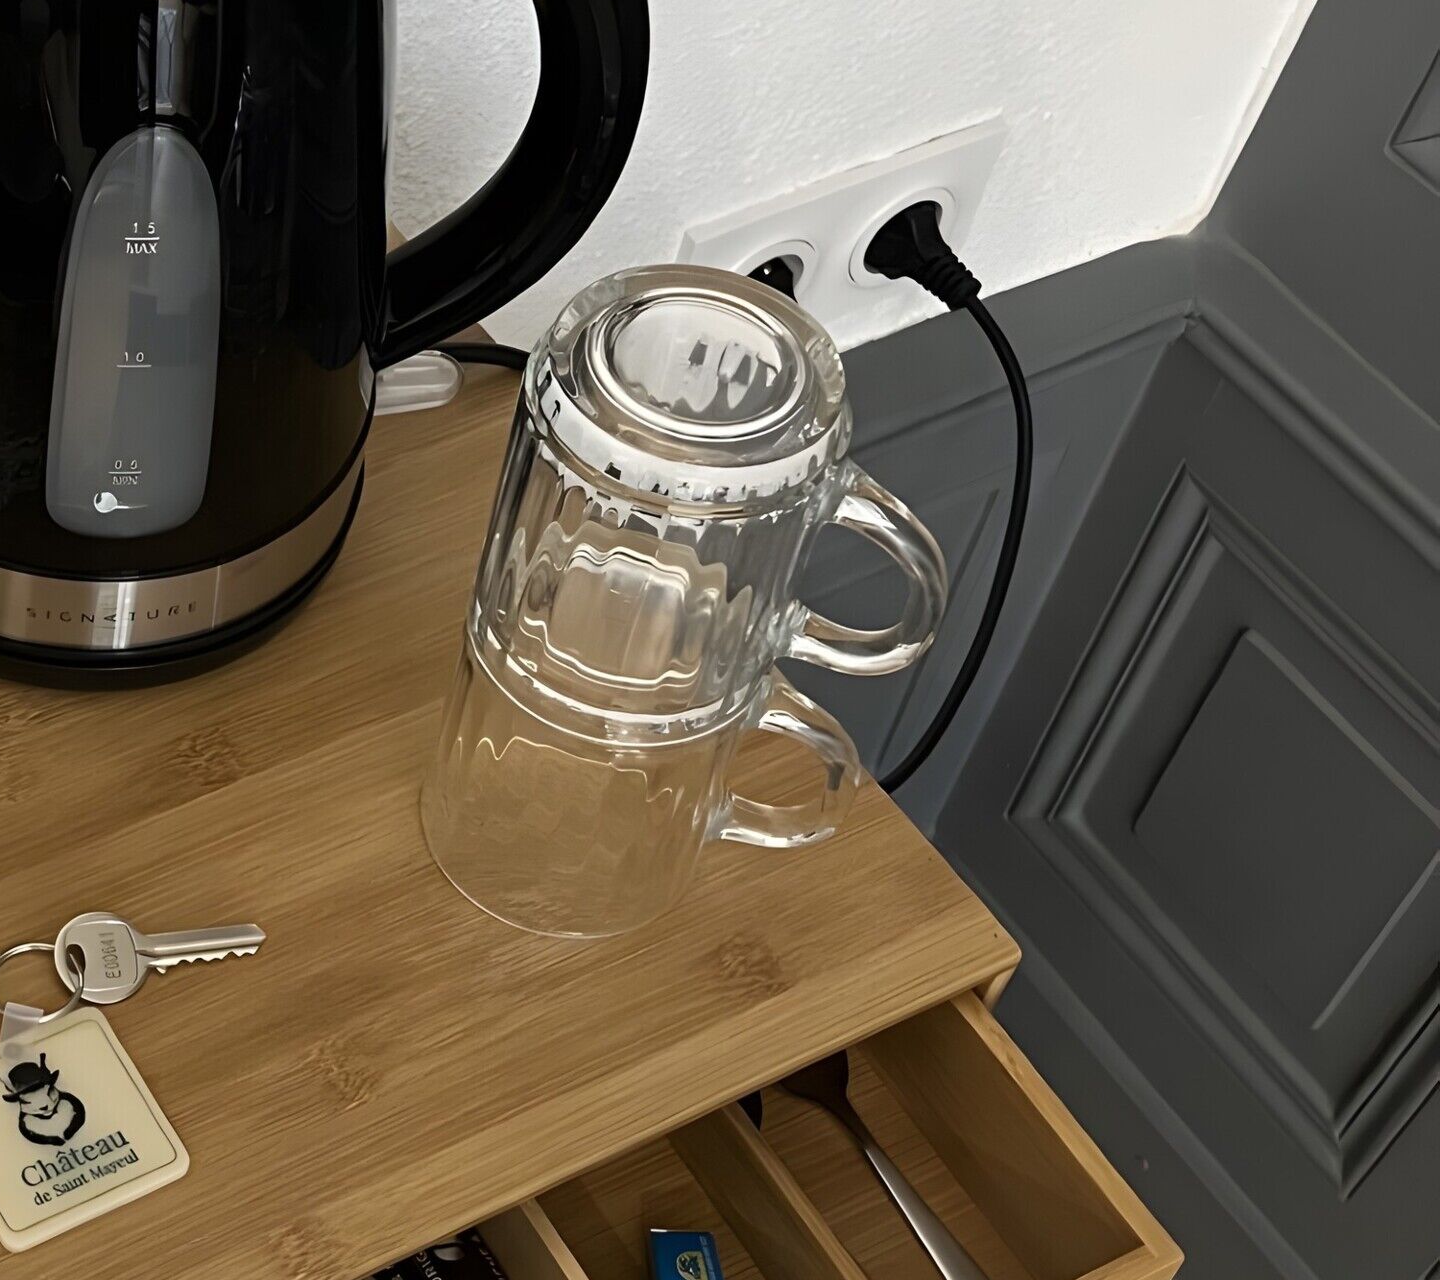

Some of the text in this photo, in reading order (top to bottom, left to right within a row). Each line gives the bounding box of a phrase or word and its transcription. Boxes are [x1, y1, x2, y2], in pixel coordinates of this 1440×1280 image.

[25, 600, 198, 624] SIGNATURE
[20, 1130, 130, 1188] Château
[33, 1190, 53, 1206] de
[52, 1172, 90, 1198] Saint
